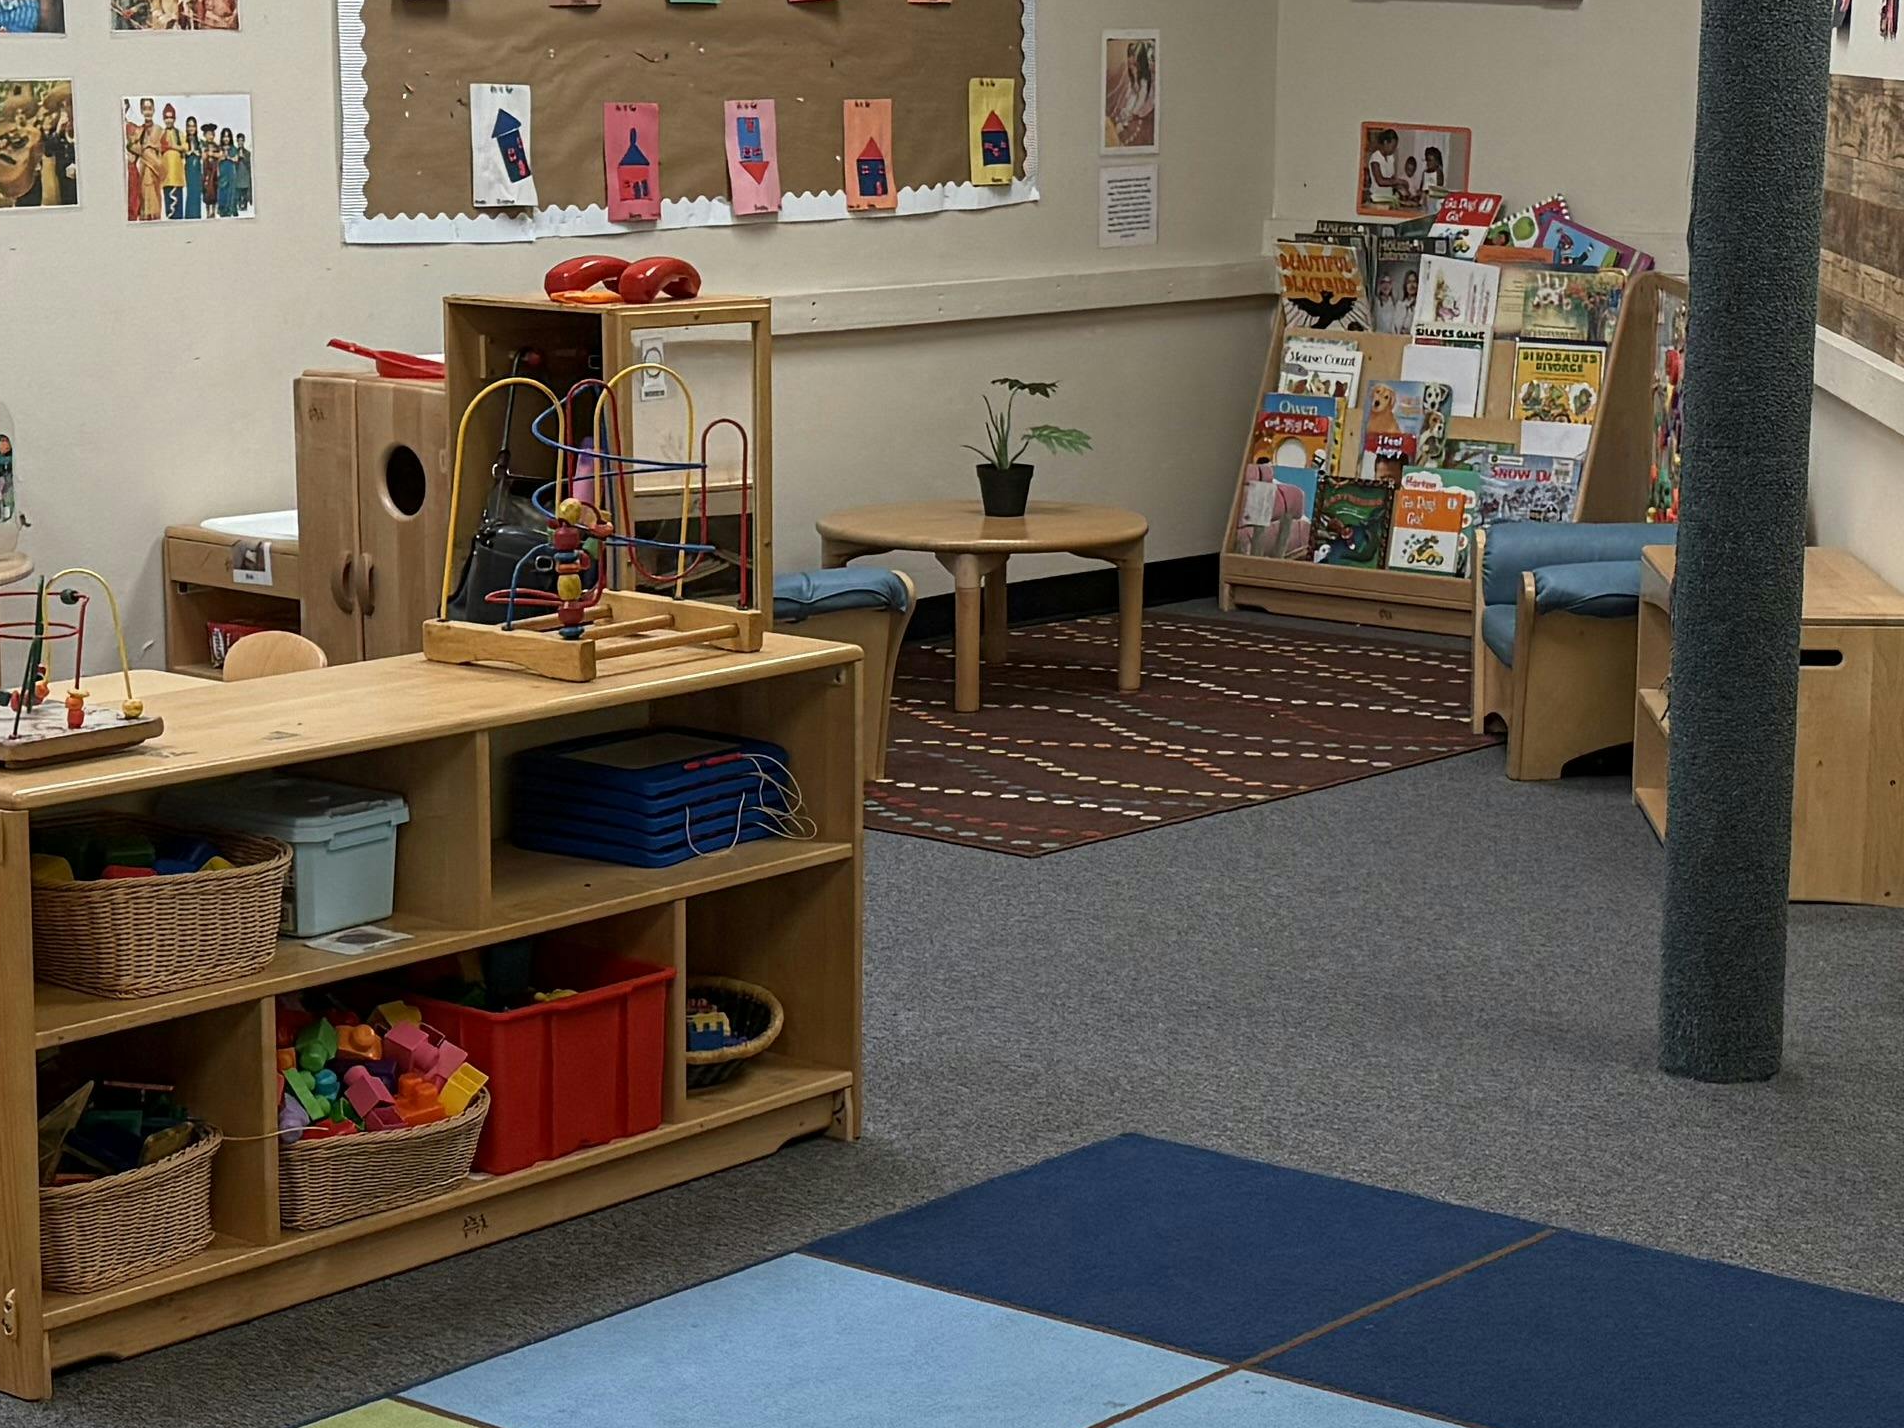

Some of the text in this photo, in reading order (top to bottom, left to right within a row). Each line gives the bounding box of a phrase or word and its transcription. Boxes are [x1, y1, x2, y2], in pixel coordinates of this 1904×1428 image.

[1279, 253, 1354, 273] BEAUTIFUL
[1416, 328, 1485, 339] SHAPES GAME
[1289, 351, 1356, 367] Mouse Count
[1522, 351, 1598, 364] DINOSAURS
[1535, 363, 1584, 373] DIVORCE
[1279, 399, 1318, 416] Owen
[1491, 467, 1531, 480] SNOW
